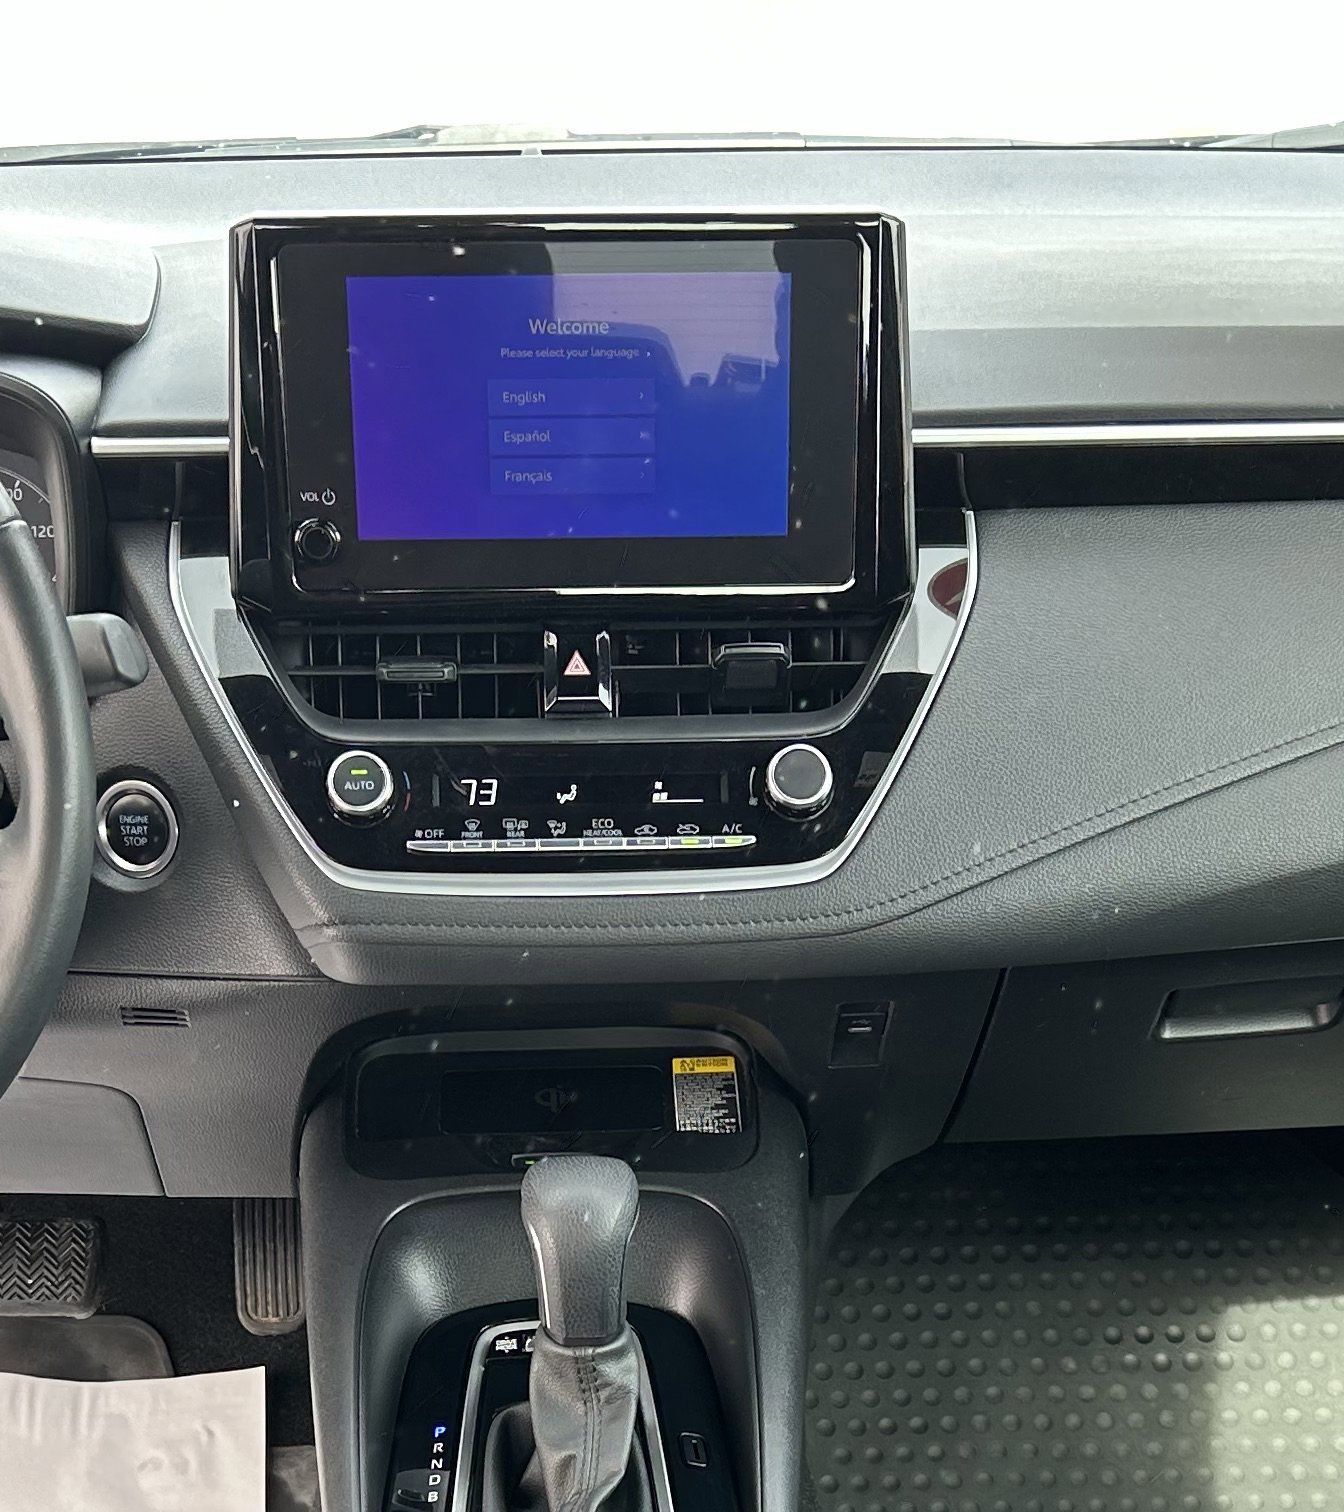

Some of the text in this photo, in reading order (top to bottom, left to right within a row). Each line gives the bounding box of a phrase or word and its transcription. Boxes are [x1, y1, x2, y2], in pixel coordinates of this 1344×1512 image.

[528, 318, 609, 335] Welcome
[500, 346, 639, 360] Please select your language
[502, 391, 545, 406] English
[503, 430, 551, 444] Español
[504, 470, 552, 484] Français
[299, 491, 319, 501] VOL
[31, 525, 56, 538] 120
[344, 780, 375, 791] AUTO
[460, 778, 498, 806] 73
[119, 815, 149, 825] ENGINE
[592, 818, 614, 829] ECO
[120, 825, 149, 836] START
[424, 828, 445, 838] OFF
[507, 830, 525, 838] REAR
[583, 828, 623, 837] HEAT/COOL
[722, 823, 743, 834] A/C
[123, 836, 148, 847] STOP
[435, 1426, 446, 1438] P
[433, 1442, 444, 1453] R
[431, 1458, 443, 1469] N
[429, 1474, 441, 1486] D
[428, 1491, 439, 1502] B
